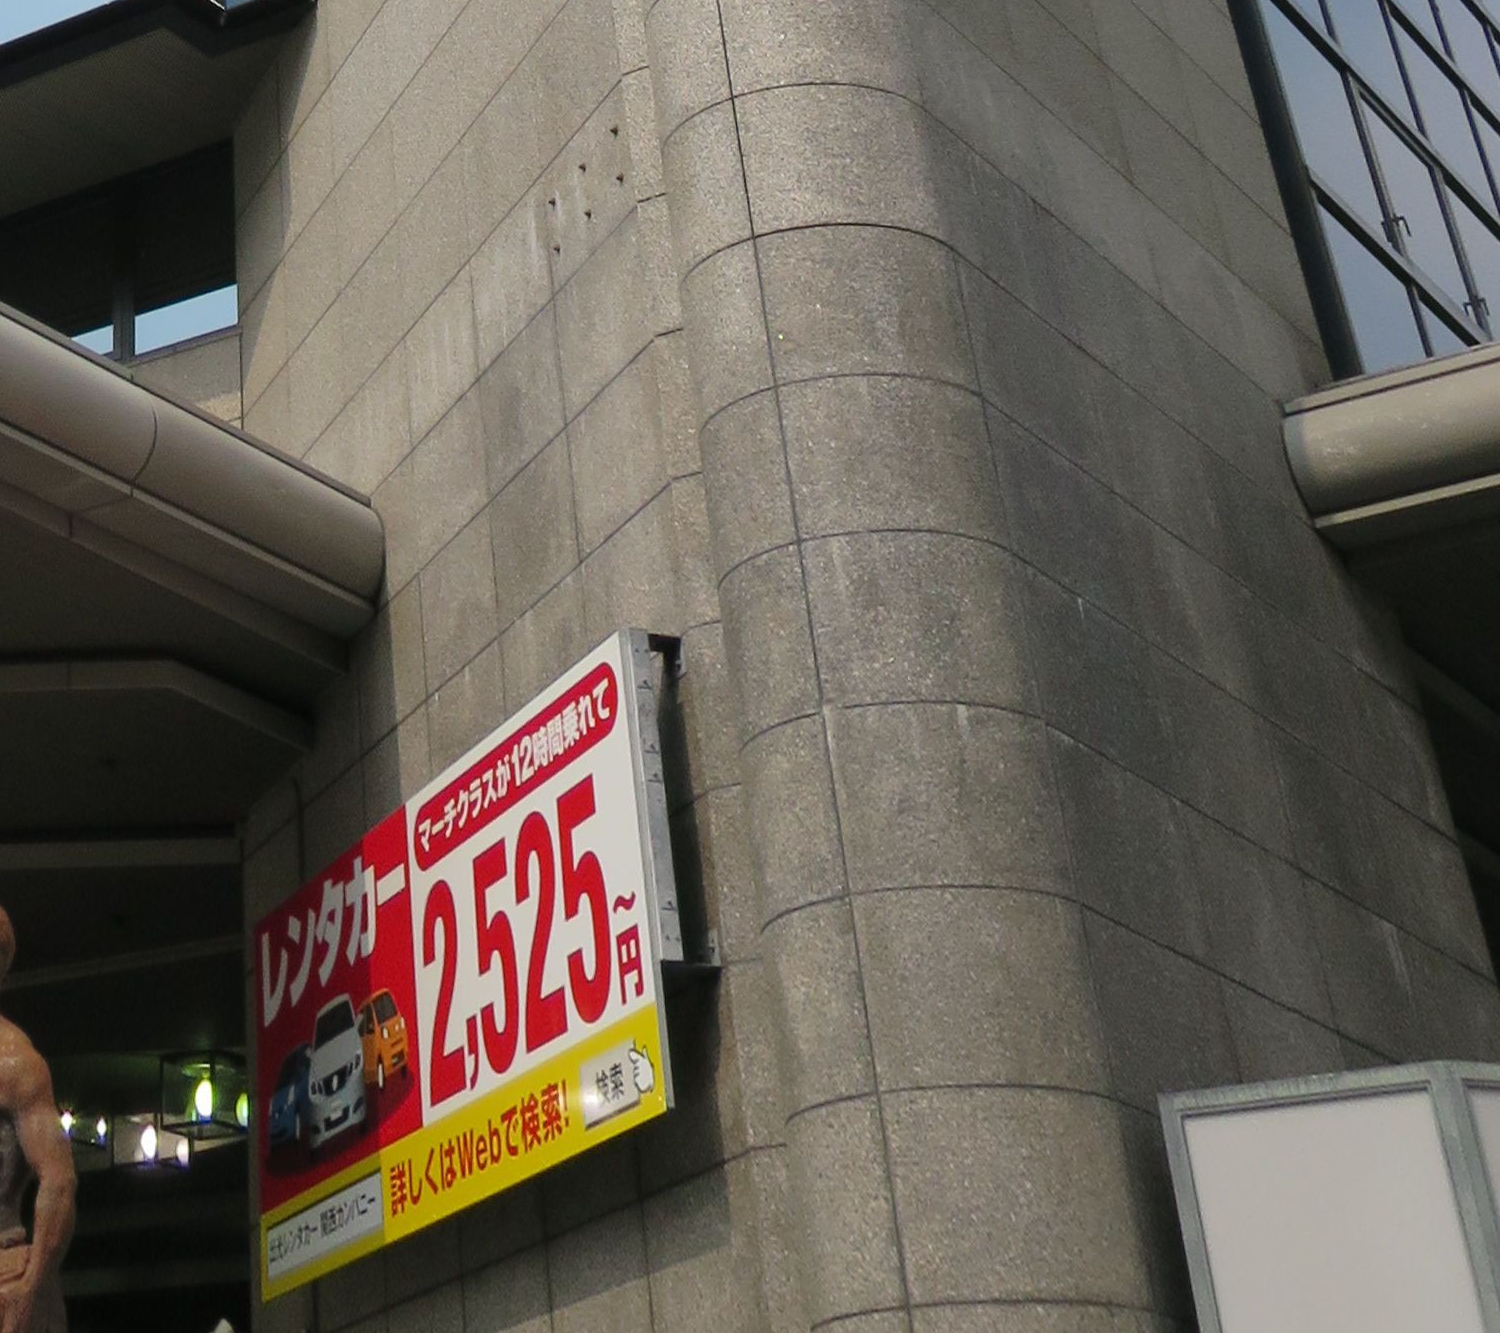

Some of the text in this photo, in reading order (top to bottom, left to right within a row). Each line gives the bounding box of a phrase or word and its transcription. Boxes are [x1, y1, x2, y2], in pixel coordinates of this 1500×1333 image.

[418, 679, 610, 852] マーチクラスが12時間乗れて
[262, 855, 406, 1027] レンタカー
[595, 1062, 625, 1103] 検索
